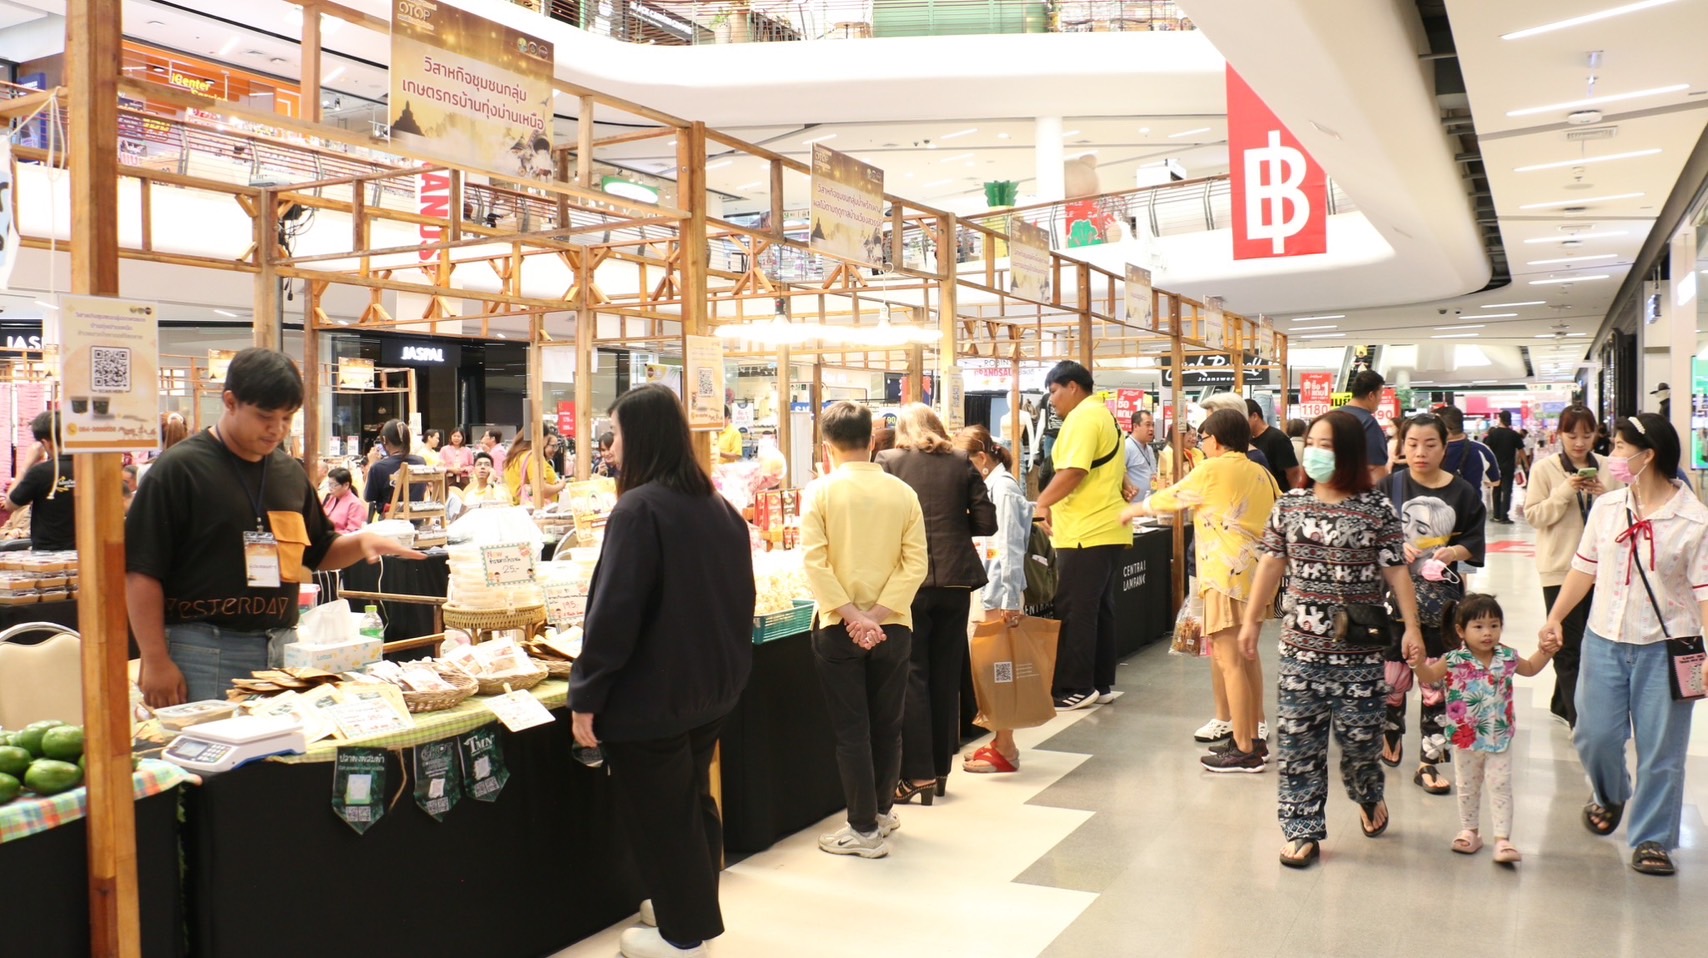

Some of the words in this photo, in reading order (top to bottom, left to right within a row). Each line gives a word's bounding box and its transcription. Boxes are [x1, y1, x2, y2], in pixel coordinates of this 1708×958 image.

[399, 1, 431, 20] OTOP
[171, 73, 211, 92] iCenter
[424, 56, 527, 104] วิสาหกิจชุมชนกลุ่ม
[402, 79, 544, 130] เกษตรกรบ้านทุ่งม่านเหนือ
[401, 346, 445, 362] JASPAL
[1302, 404, 1329, 415] 1180
